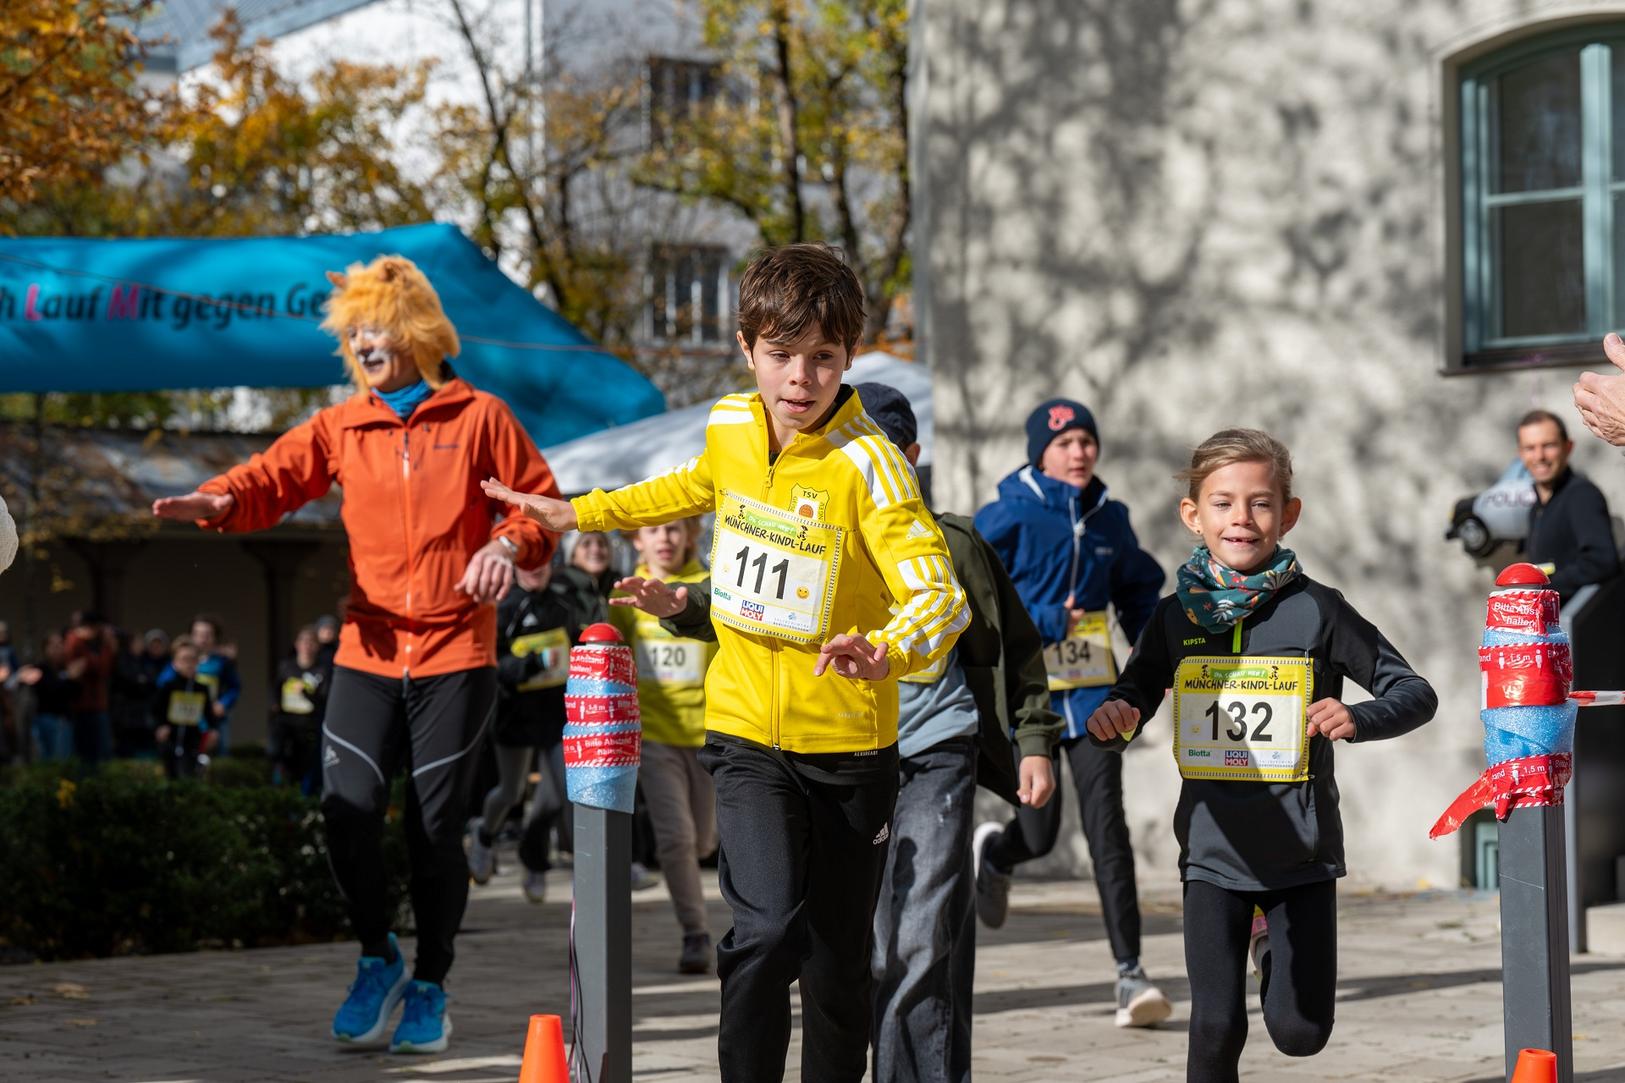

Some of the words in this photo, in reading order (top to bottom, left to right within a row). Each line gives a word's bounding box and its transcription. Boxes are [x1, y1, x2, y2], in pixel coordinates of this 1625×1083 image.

[25, 283, 104, 320] Lauf
[107, 282, 165, 320] Mit
[171, 291, 276, 332] gegen
[803, 490, 818, 499] TSV
[725, 514, 827, 555] MÜNCHNER-KINDL-LAUF
[735, 545, 790, 600] 111
[713, 587, 732, 601] Biotta
[742, 600, 764, 613] LIQUI
[741, 608, 763, 621] MOLY
[1183, 637, 1207, 646] KIPSTA
[648, 646, 687, 667] 120
[1053, 641, 1091, 666] 134
[1184, 679, 1298, 691] MÜNCHNER-KINDL-LAUF
[1205, 701, 1273, 742] 132
[1188, 749, 1211, 757] Biotta
[1225, 758, 1248, 766] MOLY
[1523, 765, 1537, 774] 1,5
